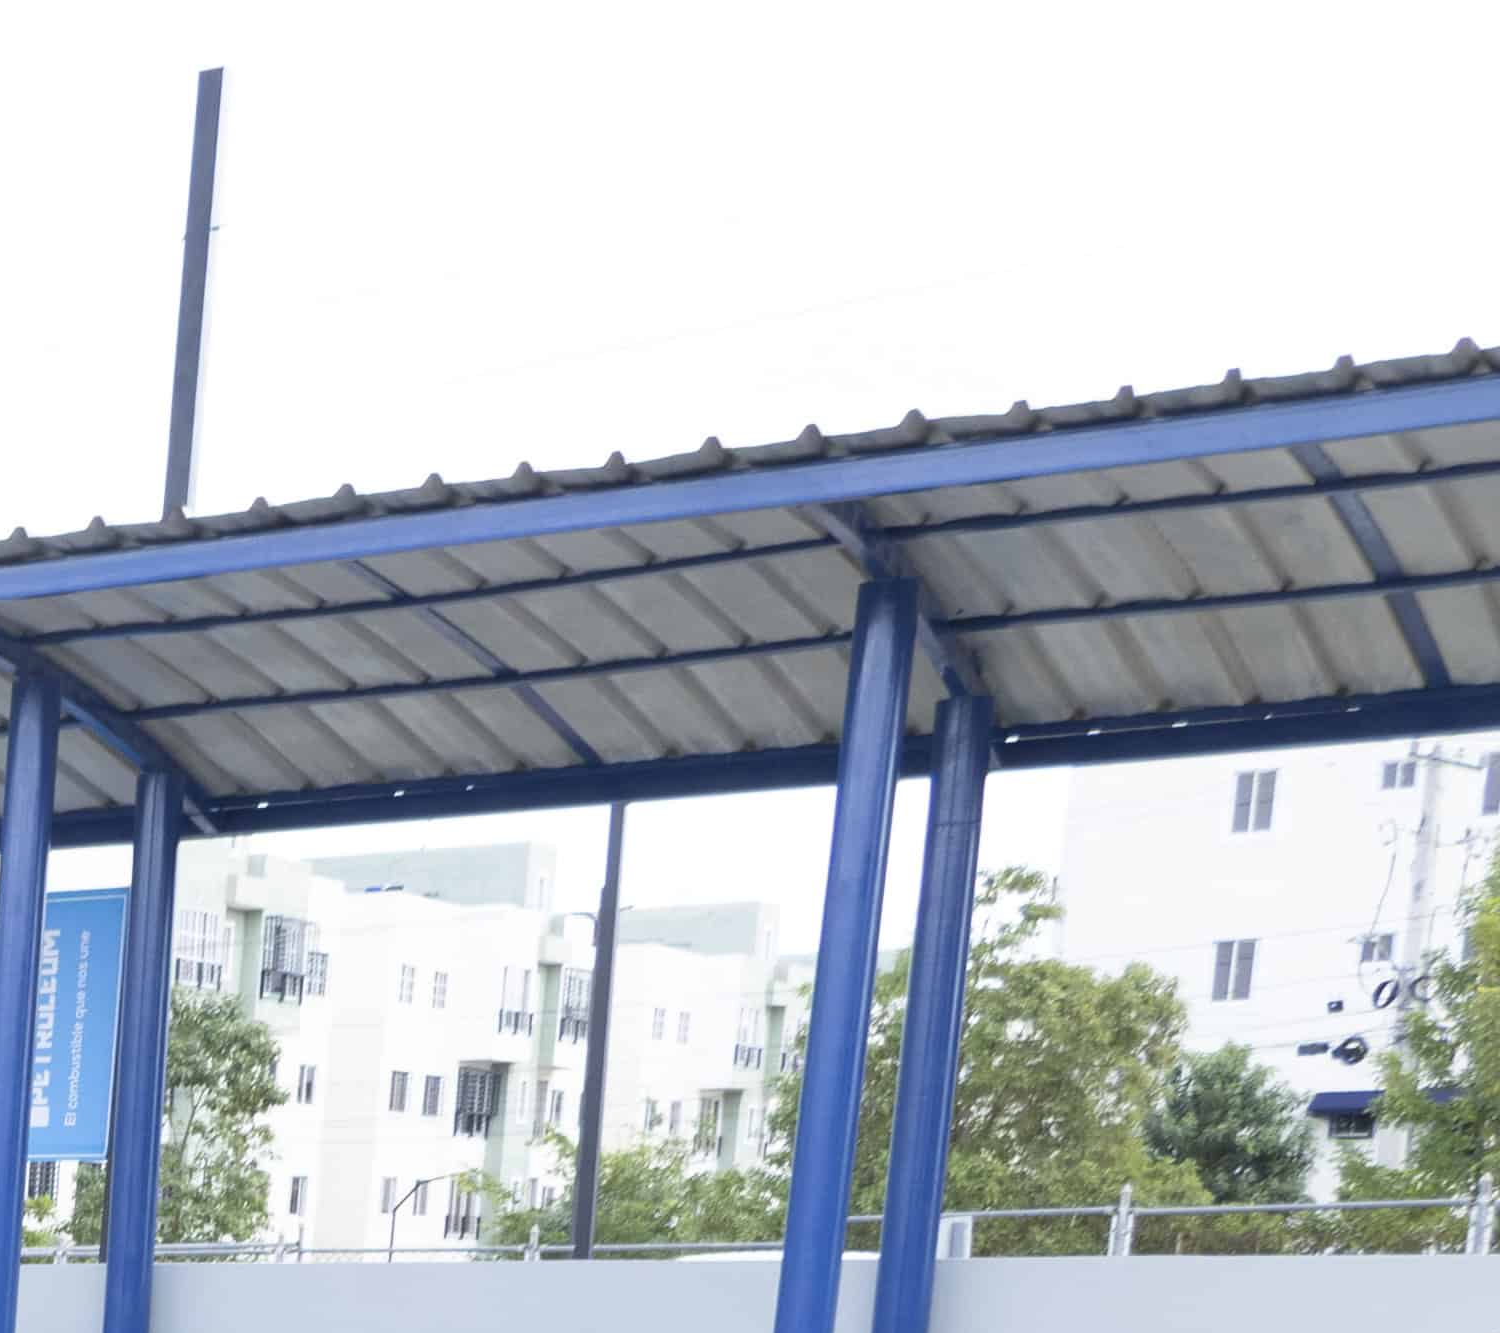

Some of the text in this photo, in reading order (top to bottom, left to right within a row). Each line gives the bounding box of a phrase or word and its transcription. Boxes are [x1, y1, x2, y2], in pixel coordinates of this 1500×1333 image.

[79, 931, 92, 958] une
[77, 960, 90, 988] nos
[74, 990, 91, 1019] que
[66, 1021, 85, 1110] combustible
